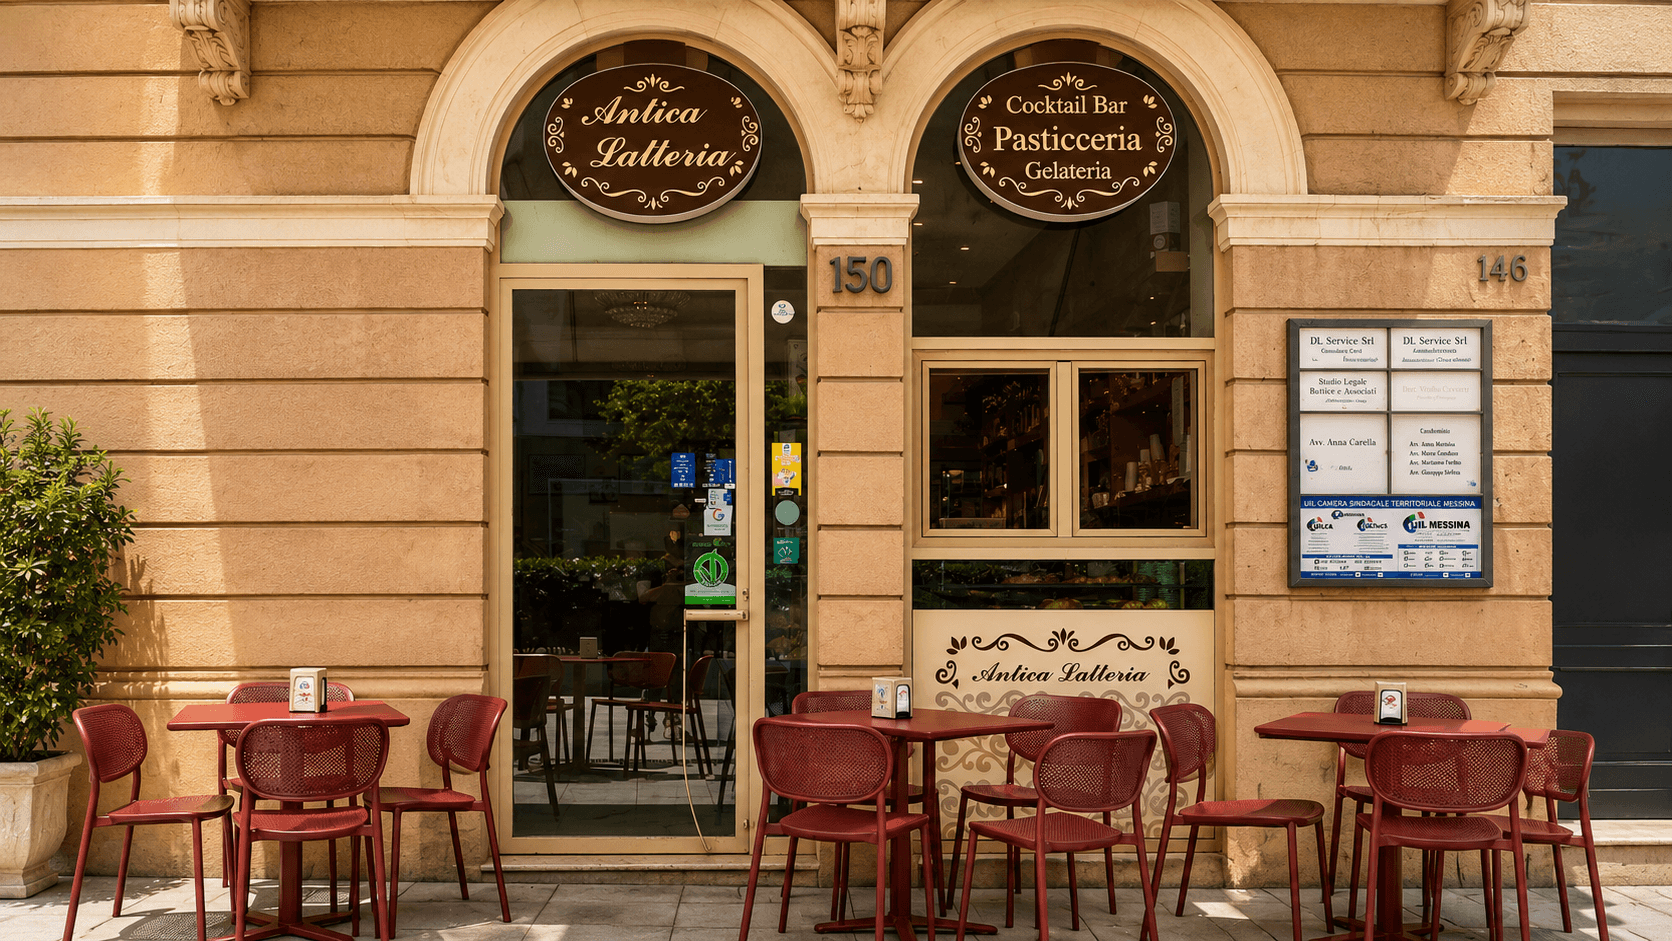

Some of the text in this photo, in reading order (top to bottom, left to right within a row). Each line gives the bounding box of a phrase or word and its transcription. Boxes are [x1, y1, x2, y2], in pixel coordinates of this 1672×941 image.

[580, 95, 708, 126] Antica
[1006, 95, 1128, 114] Cocktail Bar
[993, 125, 1143, 151] Pasticceria
[589, 136, 737, 168] Latteria
[1025, 160, 1112, 180] Gelateria
[829, 256, 893, 293] 150
[1477, 255, 1529, 282] 146
[1310, 335, 1375, 345] DL Service Srl
[1403, 335, 1468, 345] DL Service Srl
[1318, 377, 1368, 387] Studio Legale
[1327, 438, 1347, 446] Anna
[1348, 437, 1377, 446] Carella
[1429, 520, 1471, 529] MESSINA
[972, 662, 1151, 682] Antica Latteria
